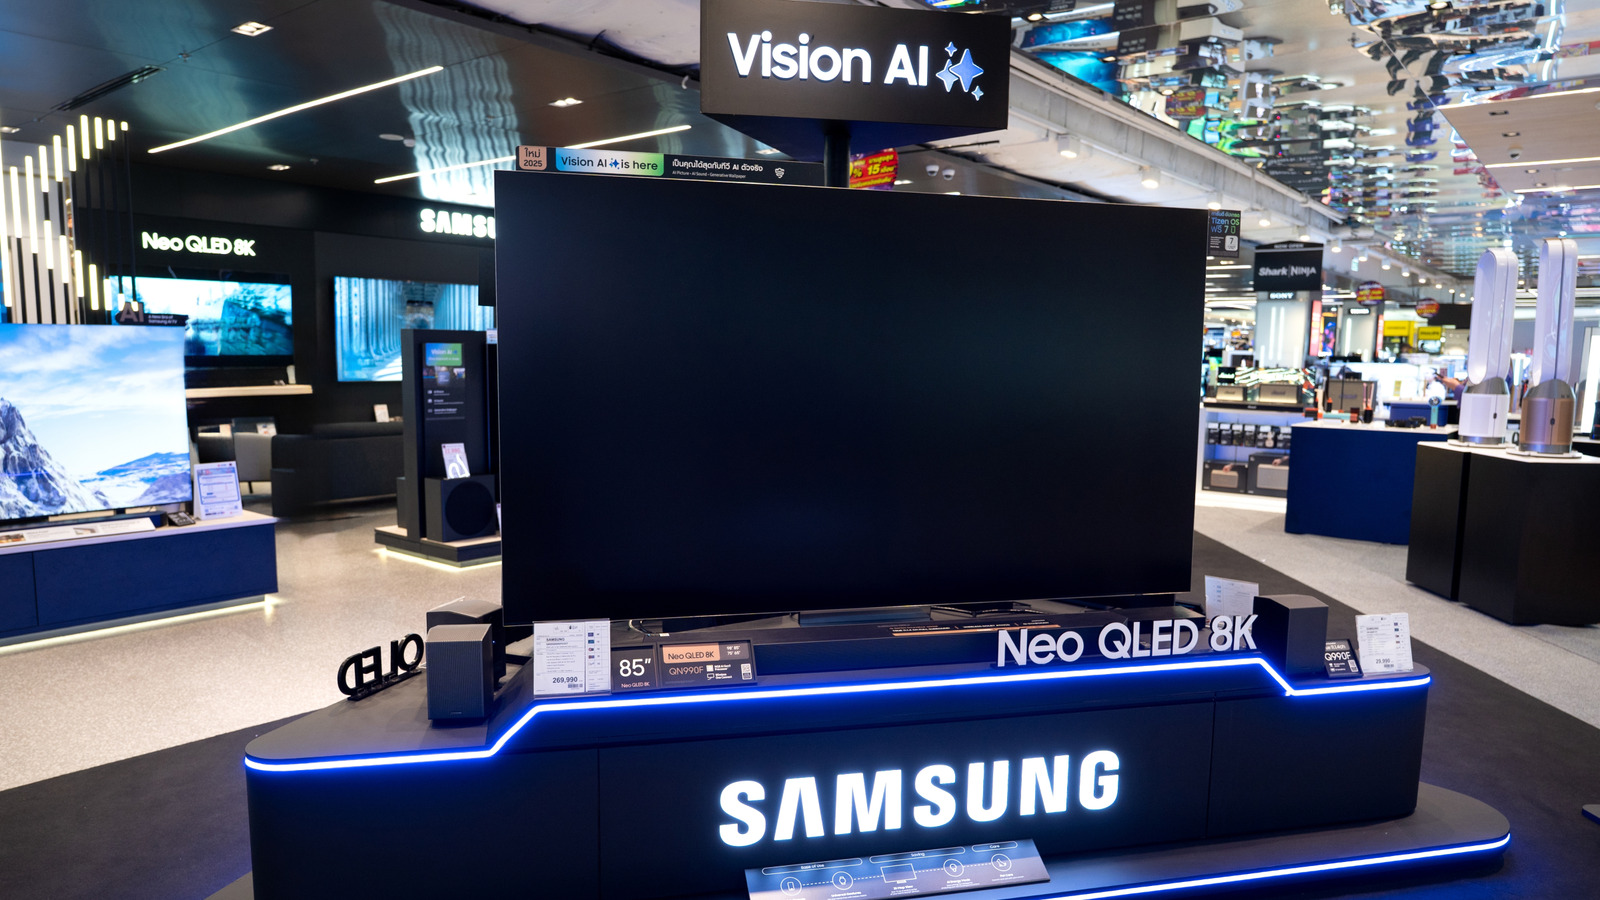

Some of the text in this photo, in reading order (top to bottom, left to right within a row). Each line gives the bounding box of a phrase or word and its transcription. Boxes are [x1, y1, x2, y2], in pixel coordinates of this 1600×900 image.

[727, 31, 929, 87] Vision AI
[524, 147, 541, 158] ใหม่
[523, 159, 543, 167] 2025
[561, 156, 659, 171] Vision AI is here
[867, 164, 880, 176] 15
[1211, 217, 1240, 226] Tizen OS
[1224, 225, 1229, 234] 7
[141, 231, 257, 257] Neo QLED 8K
[1229, 237, 1234, 245] 7
[1259, 266, 1317, 277] Shark NINJA
[997, 614, 1259, 667] Neo QLED 8K
[685, 651, 704, 659] QLED
[705, 650, 715, 658] 8K
[1324, 651, 1351, 661] Q990F
[619, 658, 652, 677] 85"
[669, 665, 704, 676] QN990F
[552, 676, 578, 684] 269,990
[719, 750, 1120, 847] SAMSUNG
